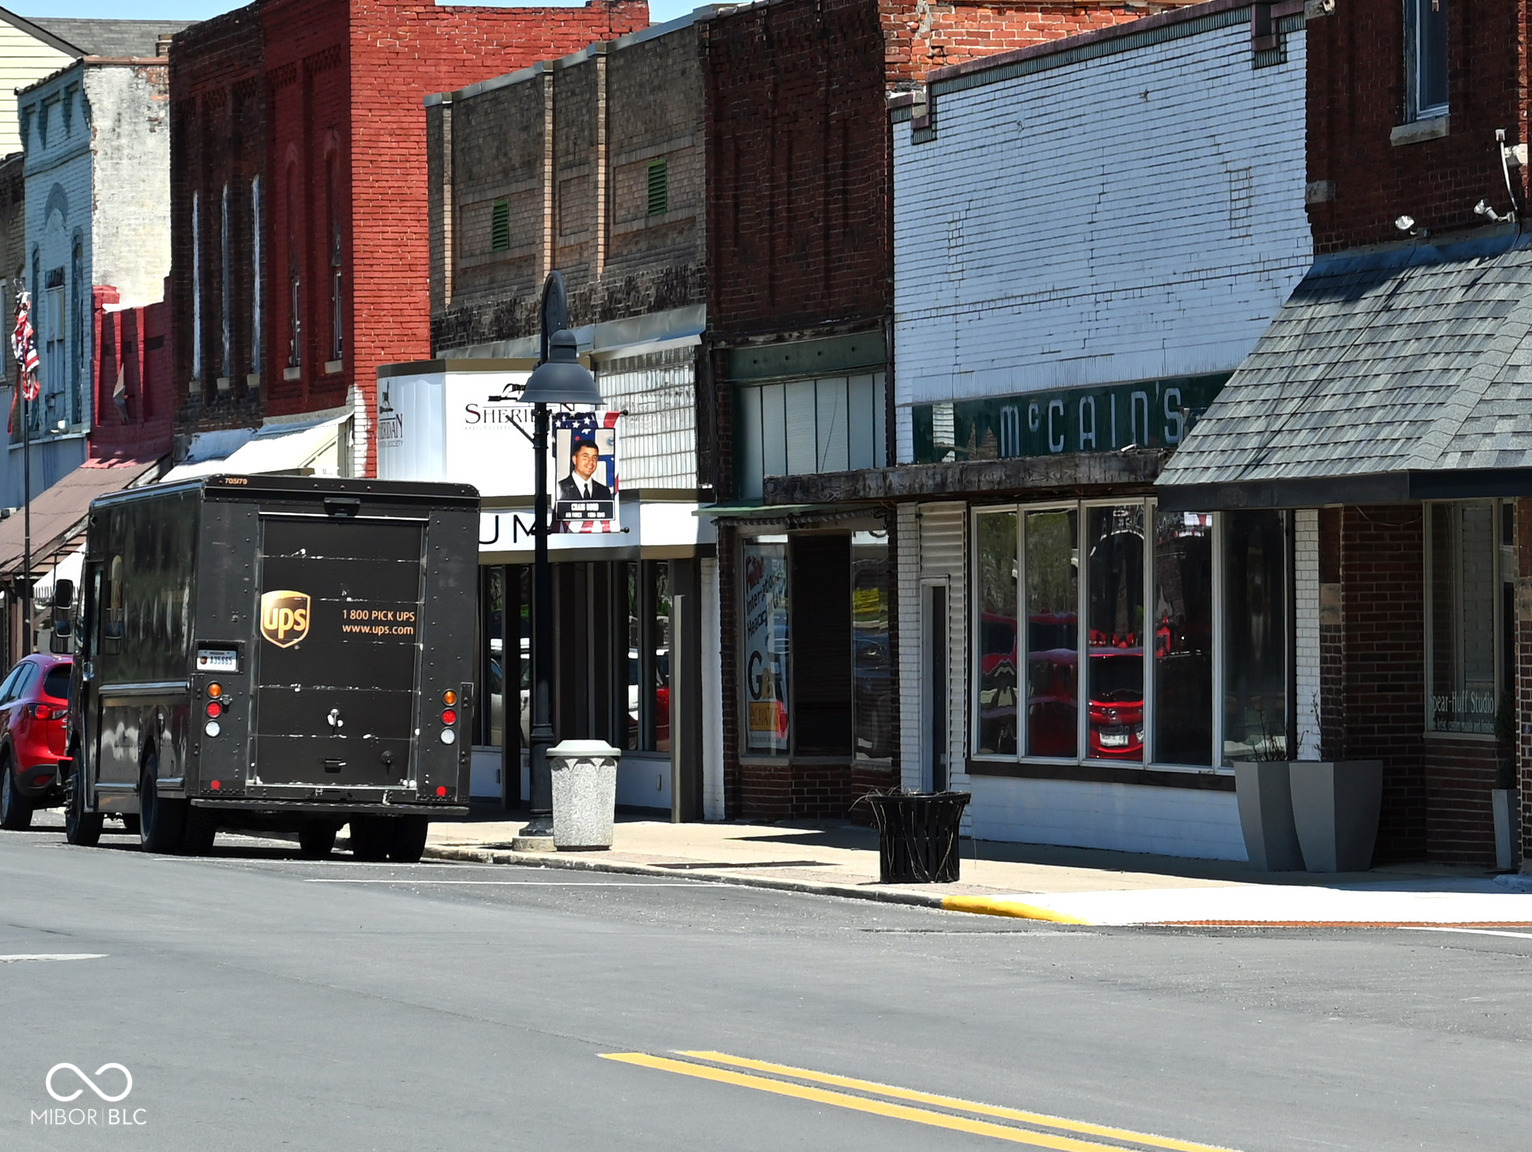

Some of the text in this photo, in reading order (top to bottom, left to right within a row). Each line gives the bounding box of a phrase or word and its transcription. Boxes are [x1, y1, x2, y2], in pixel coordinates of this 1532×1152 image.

[342, 609, 415, 622] 1 800 PICK UPS
[264, 608, 307, 639] ups
[342, 624, 414, 636] www.ups.com
